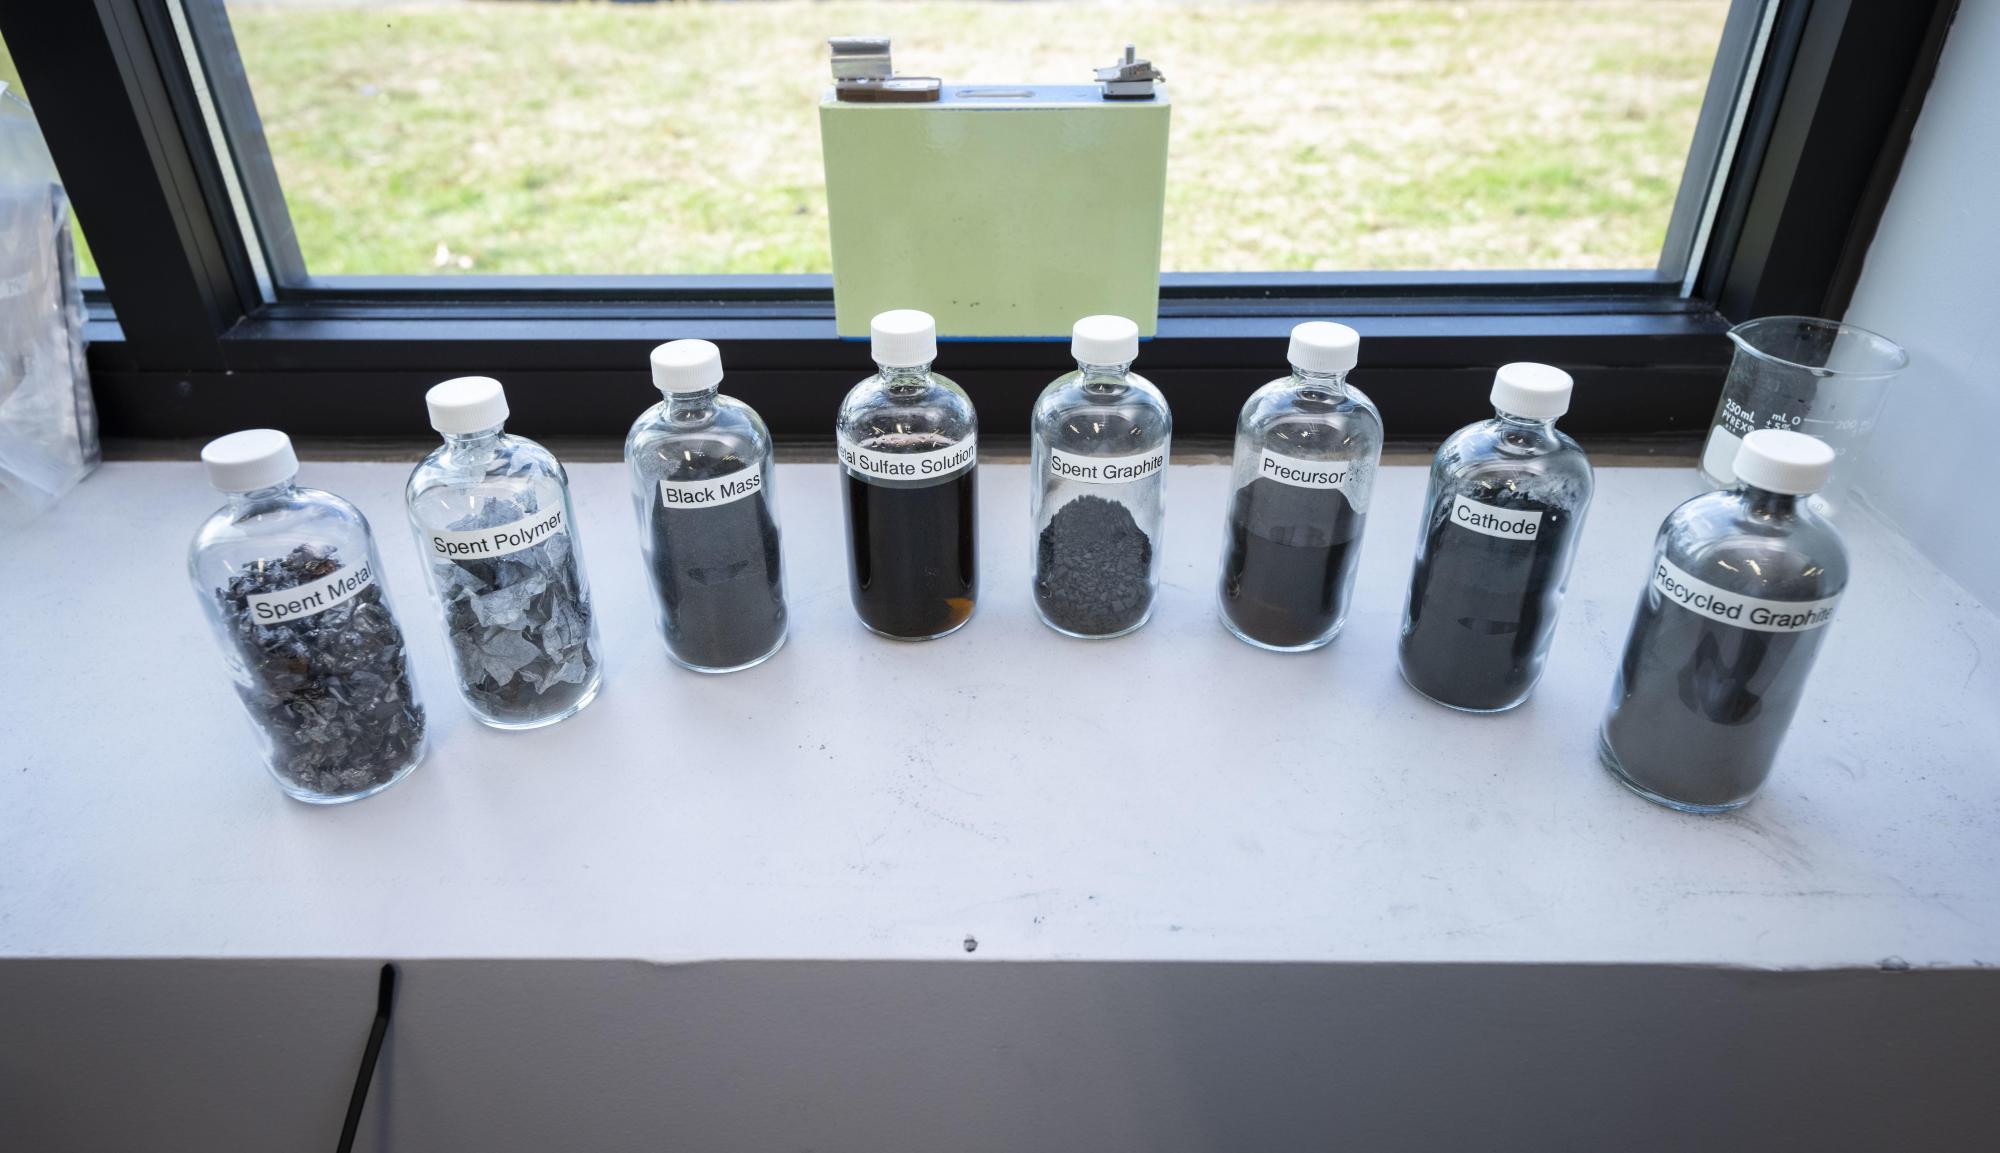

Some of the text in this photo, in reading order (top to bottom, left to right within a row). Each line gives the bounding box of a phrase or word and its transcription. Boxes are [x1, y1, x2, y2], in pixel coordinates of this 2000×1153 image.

[859, 454, 915, 475] Sulfate
[921, 445, 974, 474] Solution
[1051, 454, 1163, 479] Spent Graphite
[1263, 457, 1346, 484] Precursor
[666, 474, 760, 504] Black Mass
[433, 510, 561, 556] Spent Polymer
[1457, 504, 1537, 535] Cathode
[255, 560, 372, 619] Spent Metal
[1655, 564, 1834, 629] Recycled Graphite
